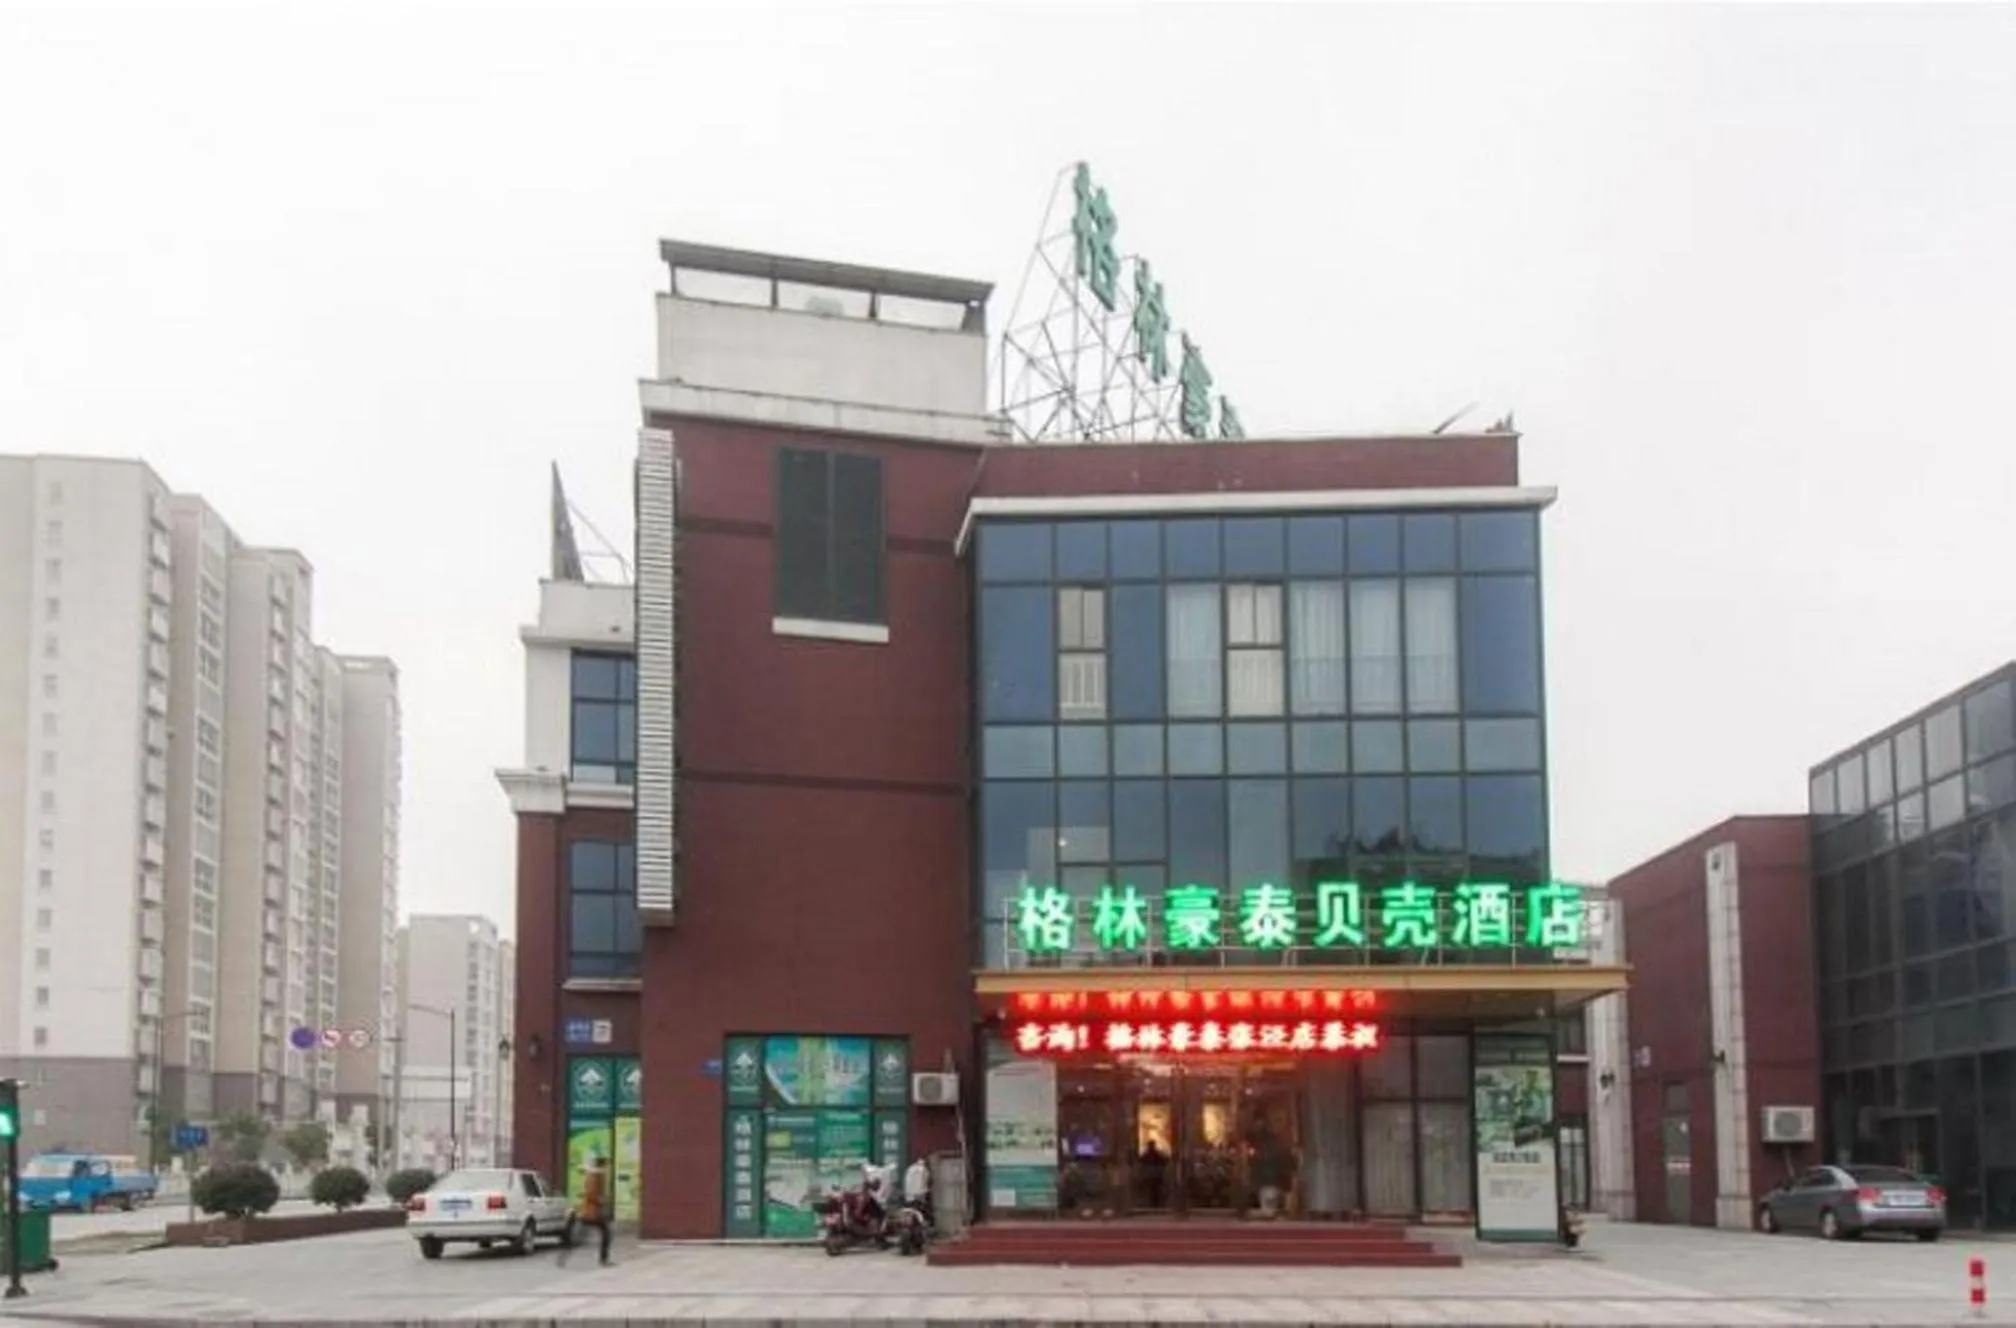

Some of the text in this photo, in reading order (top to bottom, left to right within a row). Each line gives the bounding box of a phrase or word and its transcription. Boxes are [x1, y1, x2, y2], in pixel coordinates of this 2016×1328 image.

[1018, 877, 1584, 951] 格林豪泰贝壳酒店
